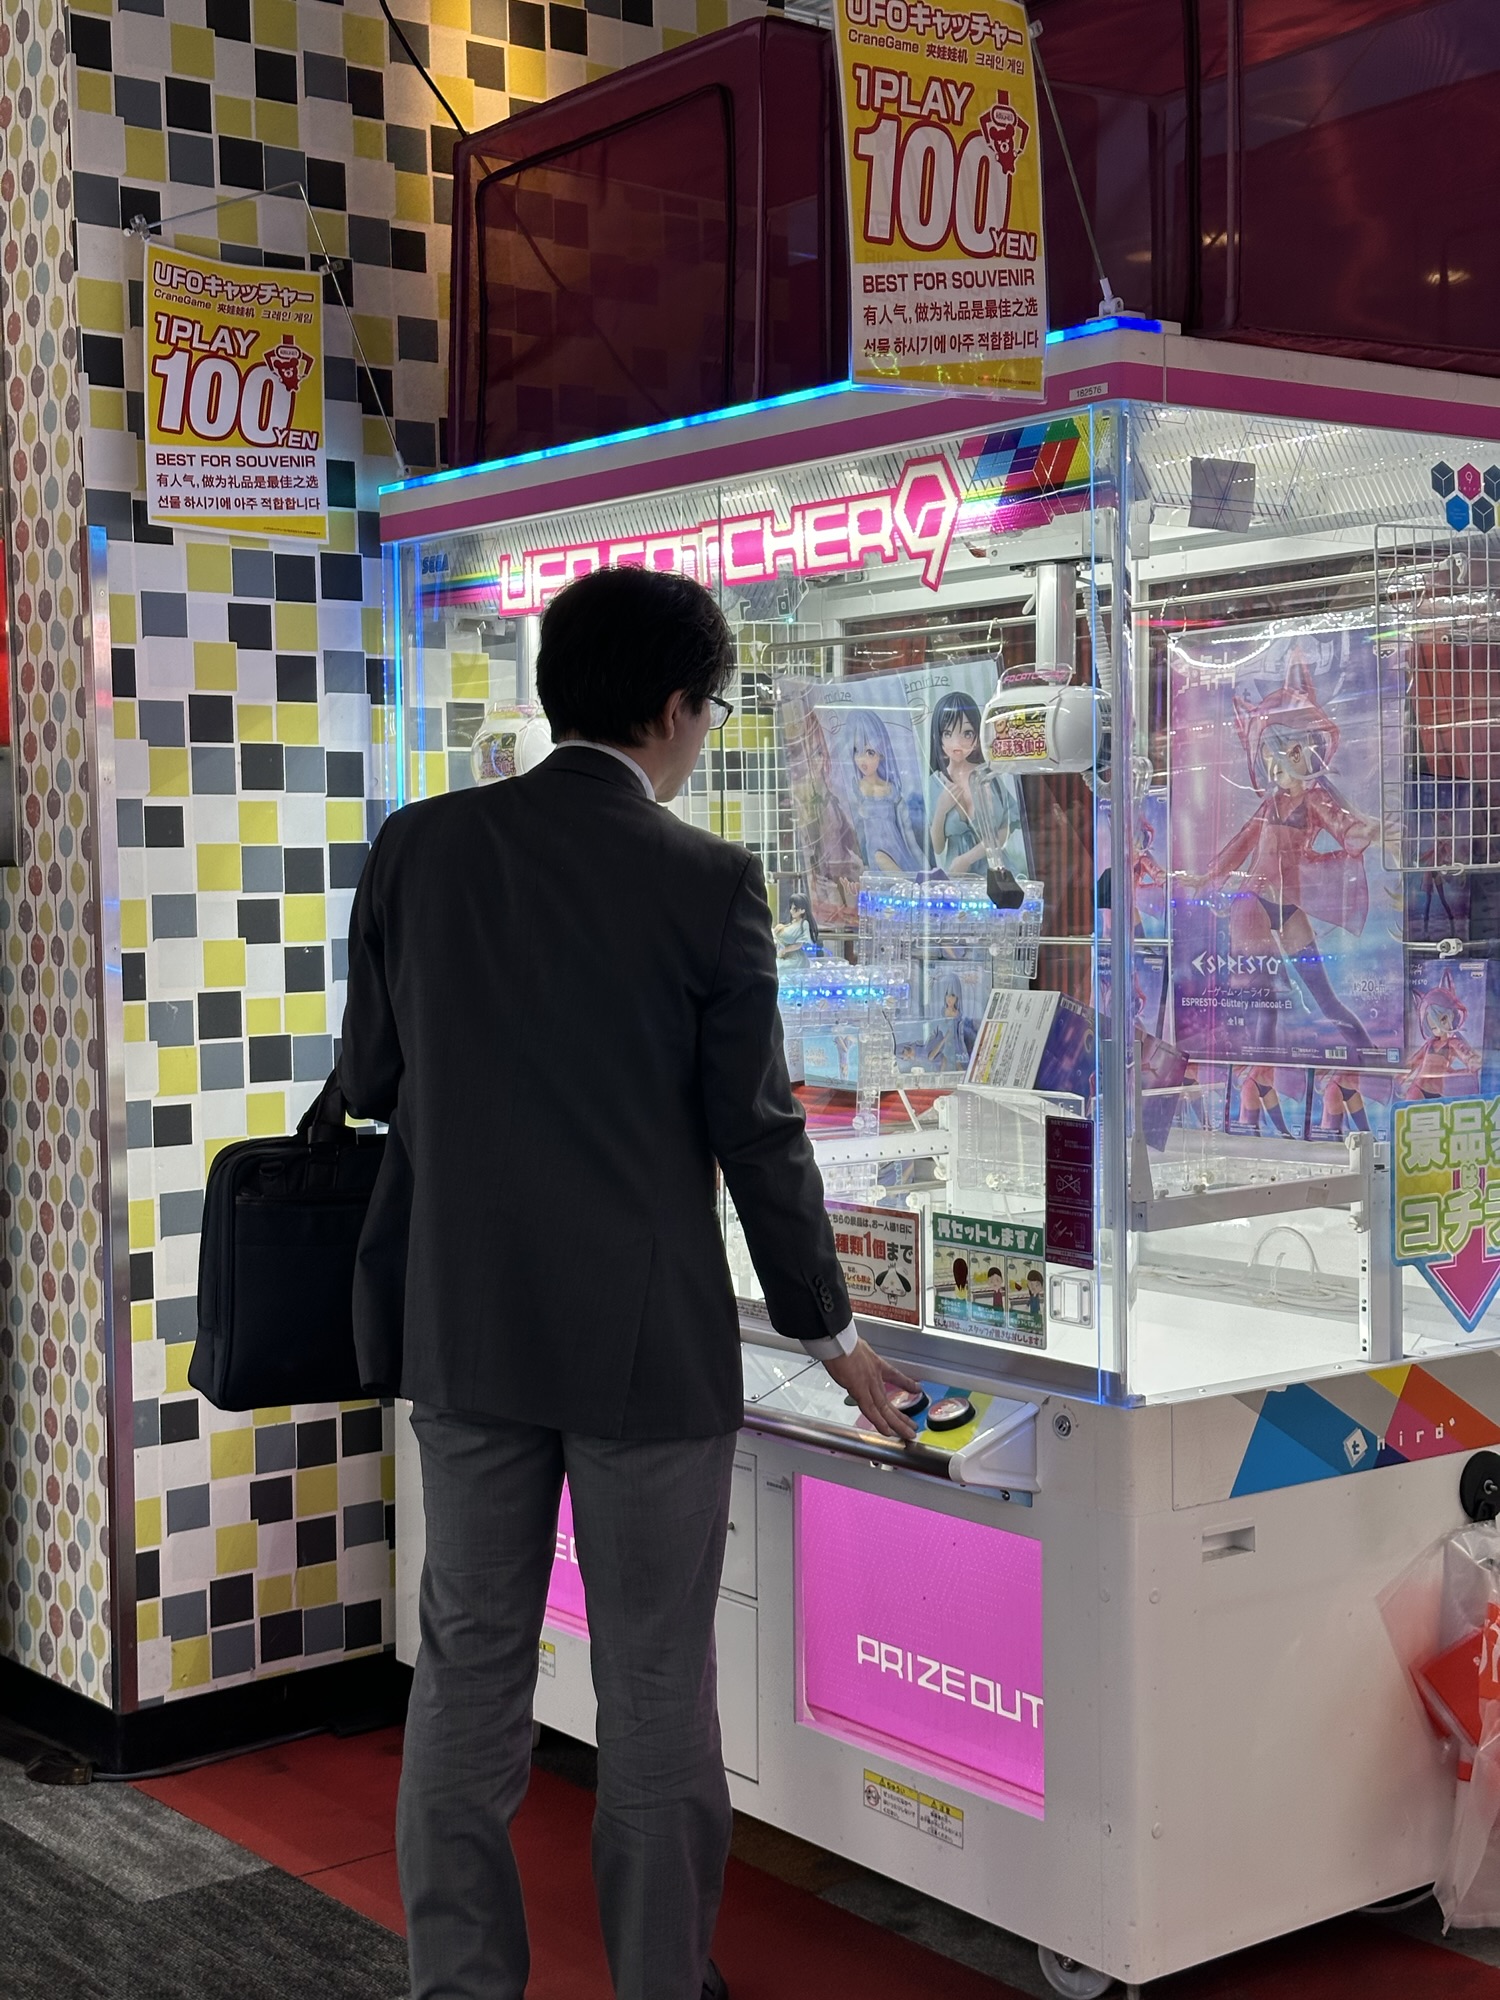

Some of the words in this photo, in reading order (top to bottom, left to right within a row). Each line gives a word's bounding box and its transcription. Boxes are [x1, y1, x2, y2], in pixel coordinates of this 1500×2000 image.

[846, 0, 1023, 51] UFOキャッチャー
[848, 29, 919, 54] CraneGame
[926, 43, 969, 64] 夹娃娃机
[975, 52, 1004, 71] 크레인
[1007, 56, 1025, 75] 게임
[853, 63, 975, 125] 1PLAY
[854, 113, 1012, 260] 100
[989, 227, 1036, 260] YEN
[154, 261, 314, 307] UFOキャッチャー
[863, 273, 908, 293] BEST
[913, 272, 947, 291] FOR
[952, 268, 1035, 289] SOUVENIR
[154, 289, 211, 310] CraneGame
[217, 303, 255, 318] 夹娃娃机
[261, 309, 291, 321] 크레인
[294, 311, 313, 324] 게임
[155, 312, 259, 359] 1PLAY
[864, 337, 891, 354] 선물
[894, 334, 946, 356] 하시기에
[950, 333, 975, 352] 아주
[978, 330, 1039, 350] 적합합니다
[152, 348, 297, 447] 100
[273, 426, 319, 450] YEN
[1076, 386, 1102, 398] 182576
[156, 453, 196, 467] BEST
[201, 455, 231, 467] FOR
[236, 455, 316, 468] SOUVENIR
[158, 495, 181, 509] 선물
[184, 496, 231, 510] 하시기에
[234, 497, 258, 510] 아주
[261, 497, 320, 510] 적합합니다
[422, 553, 449, 574] SEGA
[1191, 951, 1280, 976] ESPRESTO
[1461, 1165, 1478, 1189] は
[857, 1634, 966, 1702] PRIZE
[970, 1673, 1044, 1729] OUT
